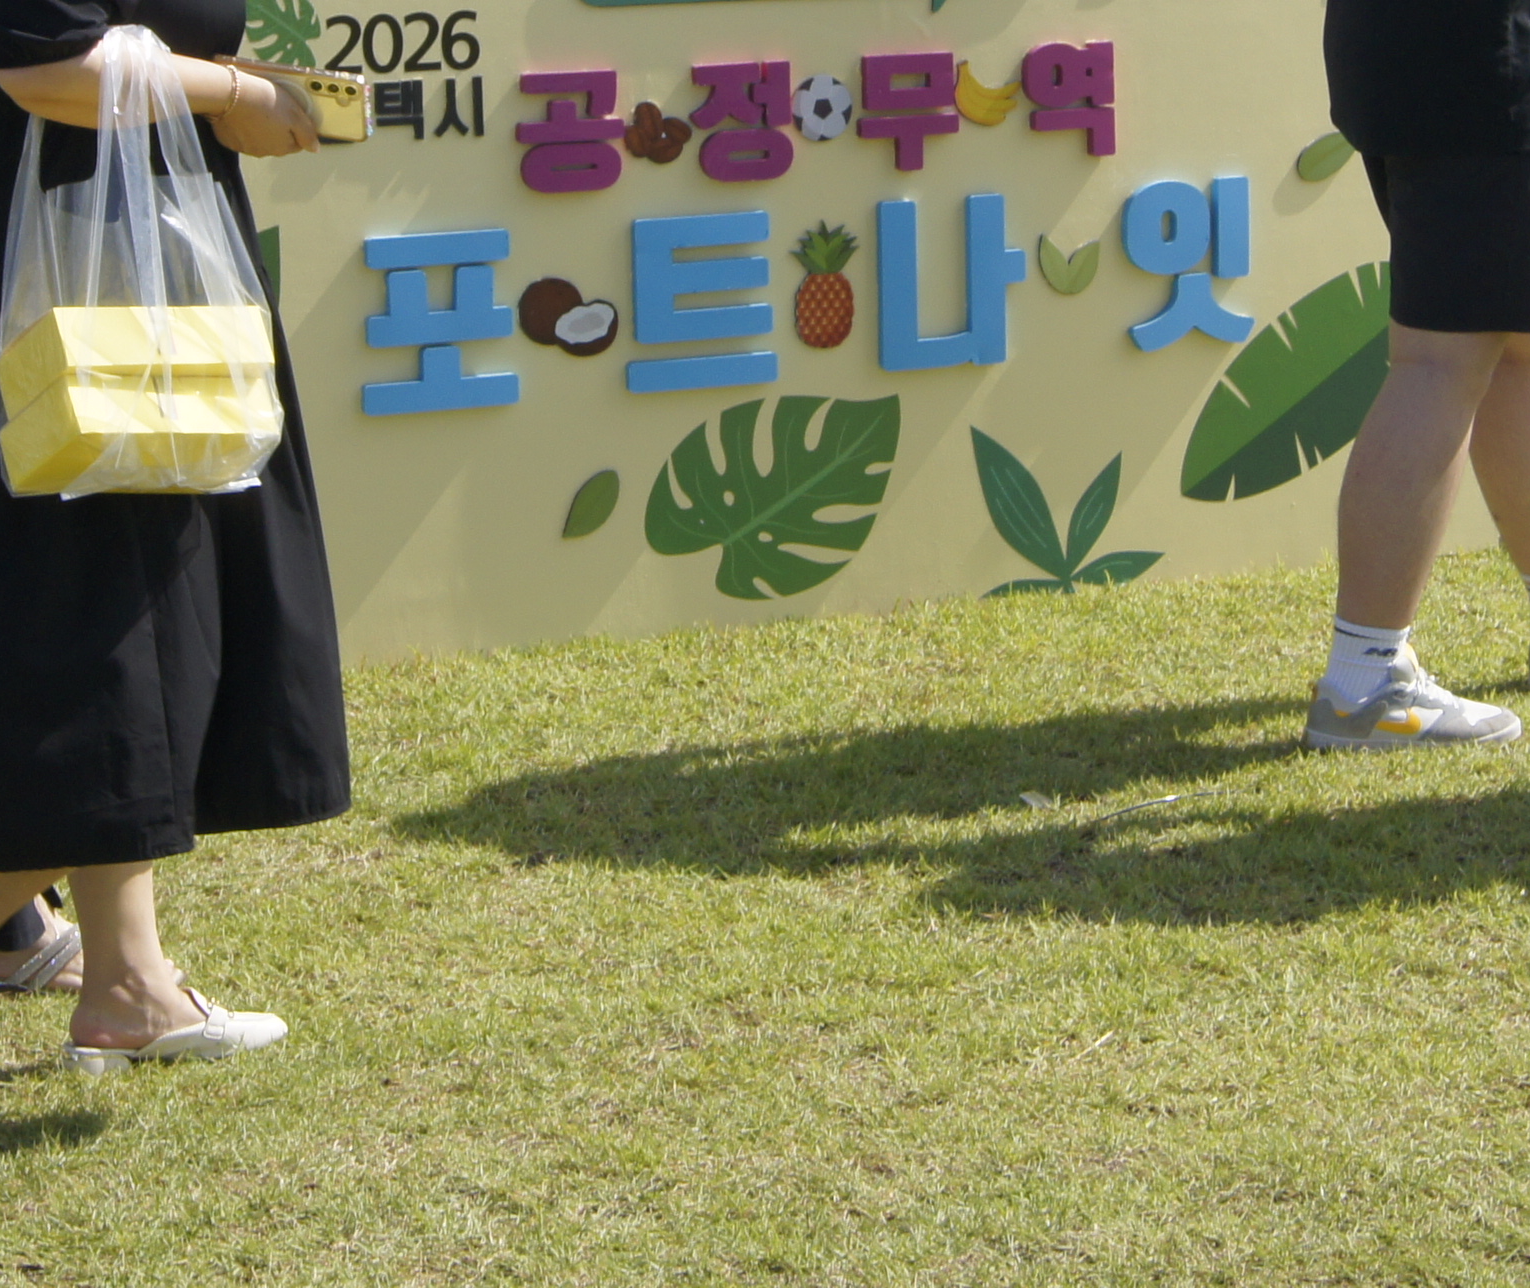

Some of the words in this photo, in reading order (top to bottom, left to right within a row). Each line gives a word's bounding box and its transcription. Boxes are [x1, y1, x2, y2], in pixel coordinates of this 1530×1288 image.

[324, 10, 481, 73] 2026
[372, 73, 484, 140] 택시
[515, 39, 1117, 193] 공정무역
[360, 175, 1255, 416] 포트나잇
